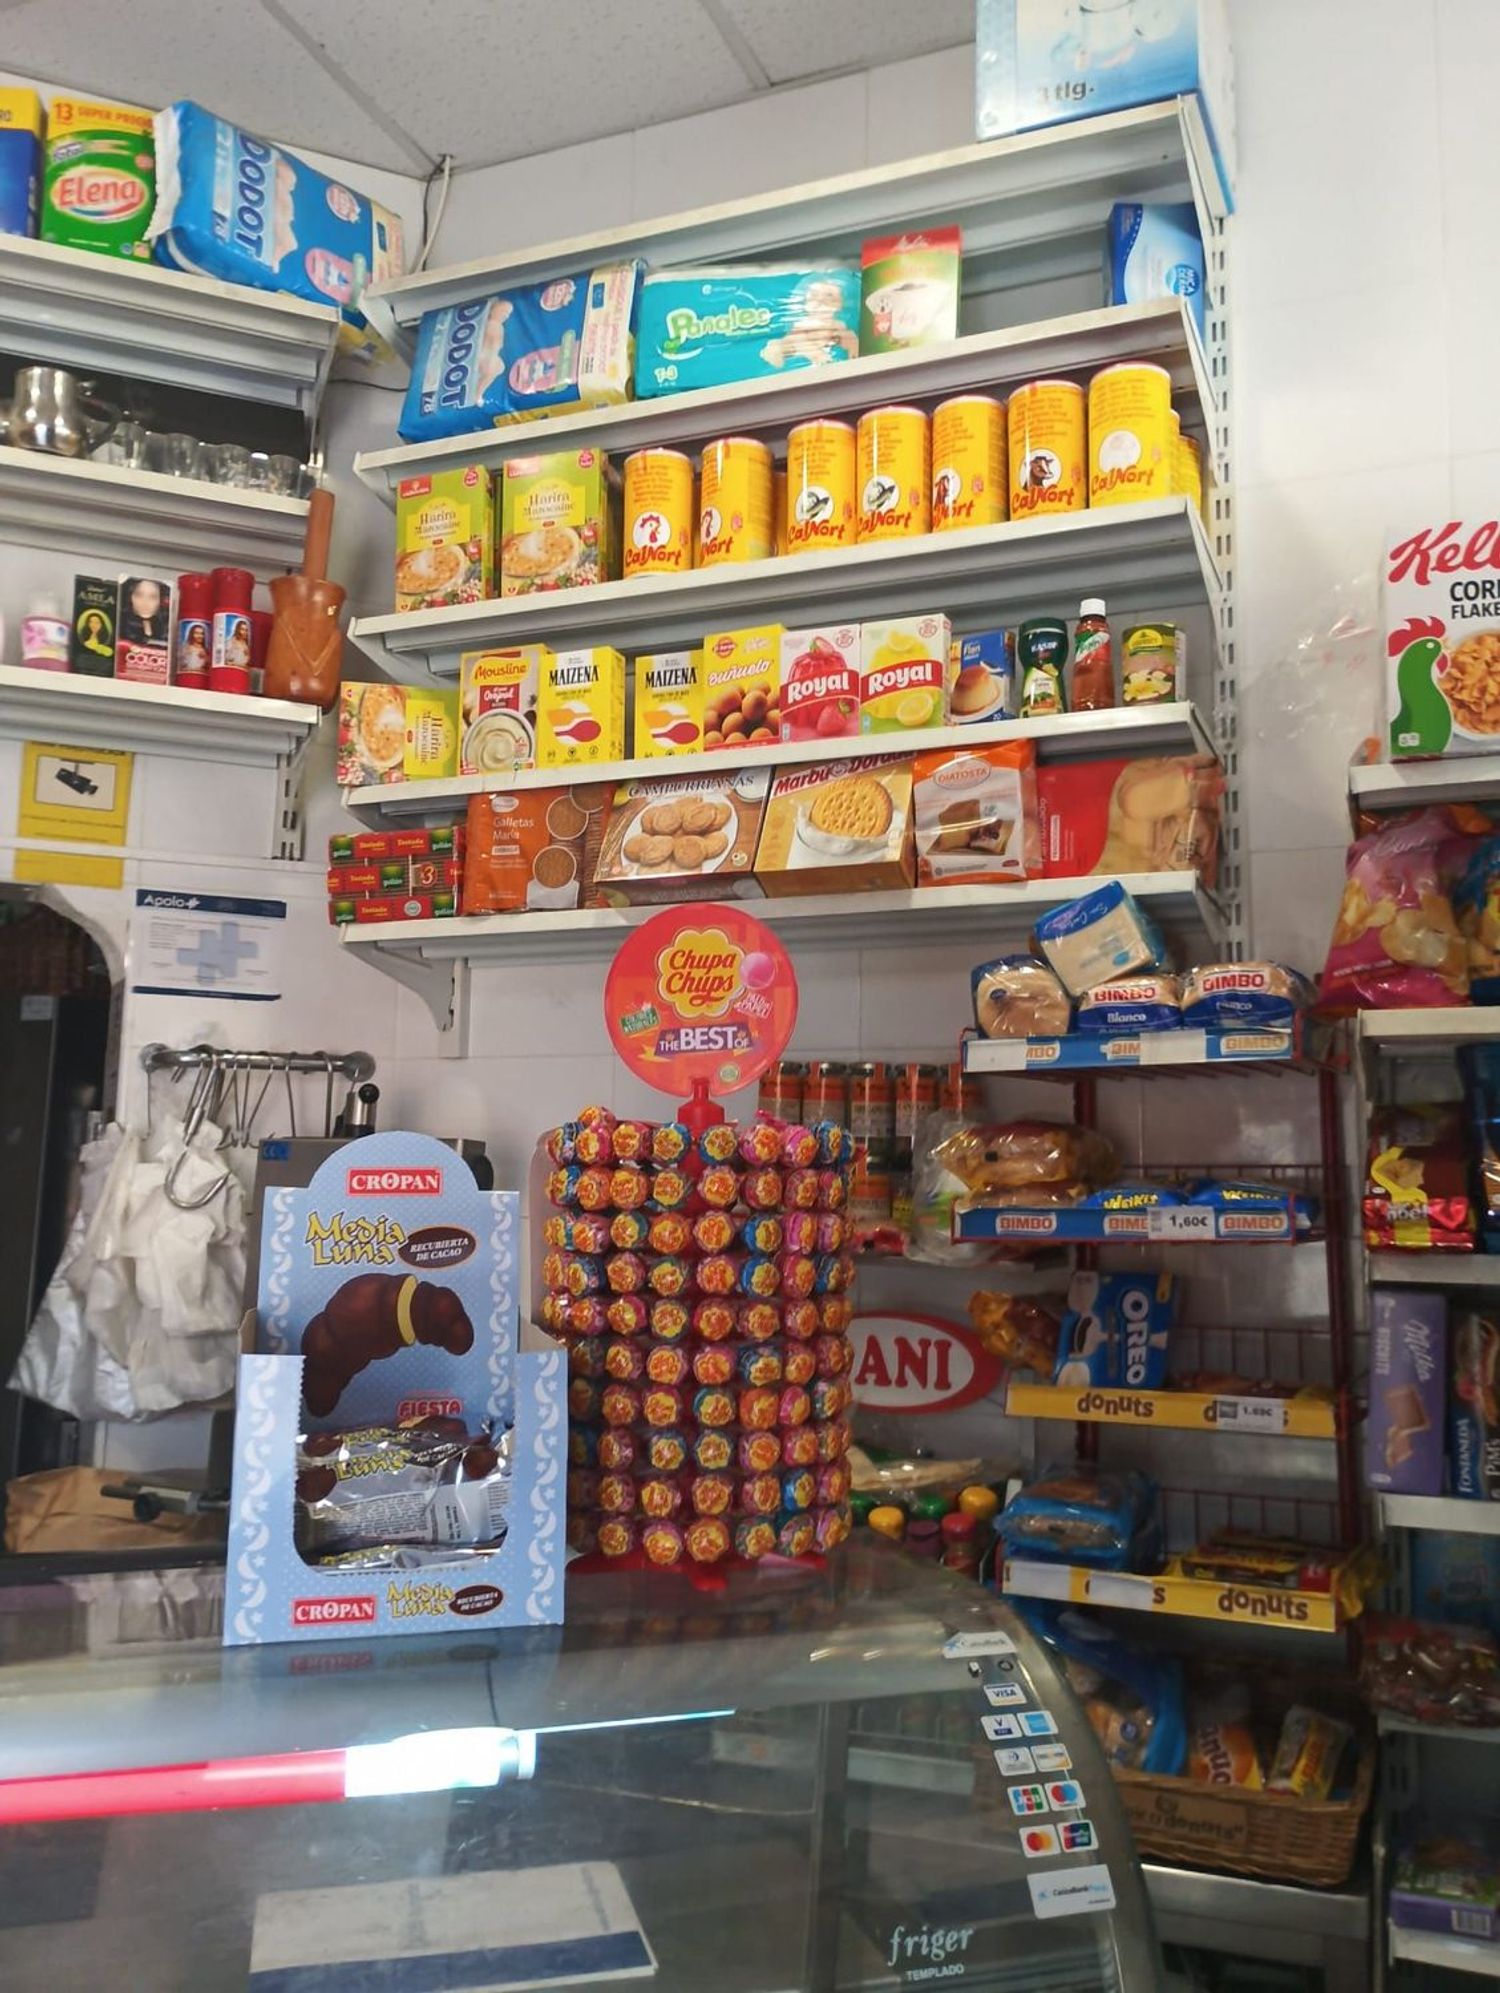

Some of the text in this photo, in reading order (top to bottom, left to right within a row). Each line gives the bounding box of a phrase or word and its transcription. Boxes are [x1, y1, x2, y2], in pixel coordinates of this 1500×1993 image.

[54, 102, 73, 121] 13
[58, 177, 138, 209] Elena
[234, 133, 272, 258] DODOT
[440, 298, 488, 409] DODOT
[1092, 464, 1154, 495] CalNort
[1012, 484, 1075, 514] CalNort
[787, 518, 845, 544] CalNort
[625, 544, 682, 567] CalNort
[1450, 579, 1500, 602] COR
[473, 662, 527, 681] Mousline
[548, 665, 600, 687] MAIZENA
[645, 667, 698, 689] MAIZENA
[868, 663, 933, 696] Royal
[788, 671, 850, 704] Royal
[493, 816, 535, 829] Galletas
[143, 893, 185, 909] Apolo
[669, 949, 737, 977] Chupa
[665, 970, 734, 1003] Chups
[1203, 972, 1265, 992] BIMBO
[1094, 987, 1157, 1002] BIMBO
[1107, 1011, 1147, 1024] Blanco
[659, 1025, 751, 1052] THE BEST OF
[1110, 1041, 1140, 1057] BIM
[1224, 1036, 1288, 1052] BIMBO
[1026, 1046, 1057, 1060] MBO
[350, 1171, 440, 1192] CROPAN
[305, 1212, 408, 1245] Media
[1001, 1217, 1053, 1230] BIMBO
[1169, 1215, 1209, 1228] 1,60€
[1223, 1215, 1284, 1230] BIMBO
[312, 1236, 397, 1266] Luna
[410, 1236, 470, 1254] RECUBIERTA
[416, 1247, 463, 1262] DE CACAO
[1120, 1290, 1150, 1385] OREO
[1403, 1318, 1435, 1383] Milka
[854, 1335, 953, 1390] ANI
[399, 1401, 461, 1417] FIESTA
[1077, 1392, 1154, 1418] donuts
[387, 1581, 456, 1601] Media
[295, 1601, 374, 1622] CROPAN
[391, 1598, 446, 1618] Luna
[1218, 1587, 1308, 1621] donuts
[993, 1688, 1017, 1698] VISA
[887, 1924, 975, 1967] friger
[906, 1963, 966, 1981] TEMPLADO
